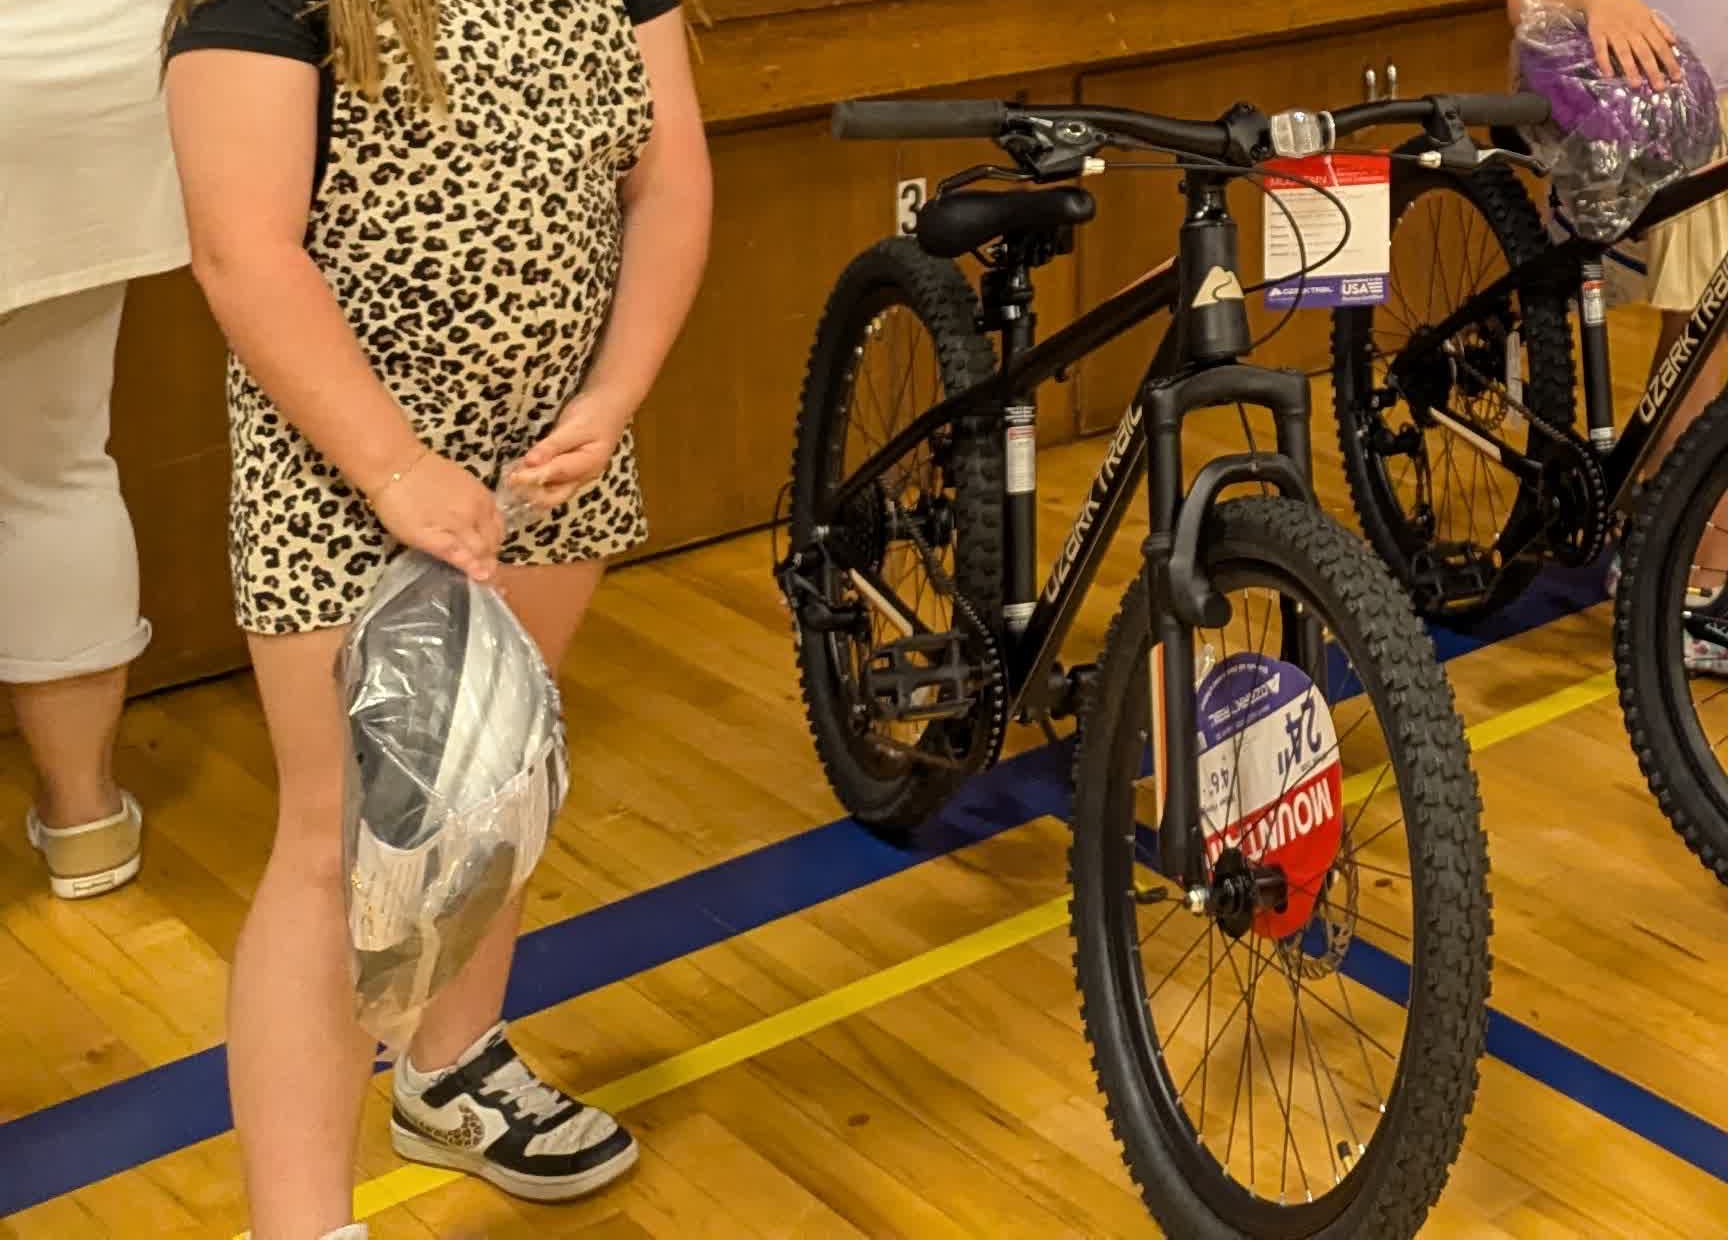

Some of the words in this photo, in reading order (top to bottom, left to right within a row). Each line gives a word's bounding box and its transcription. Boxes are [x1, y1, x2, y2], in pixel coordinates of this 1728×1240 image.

[902, 183, 922, 234] 3
[1343, 283, 1369, 295] USA
[1278, 693, 1323, 776] 24"
